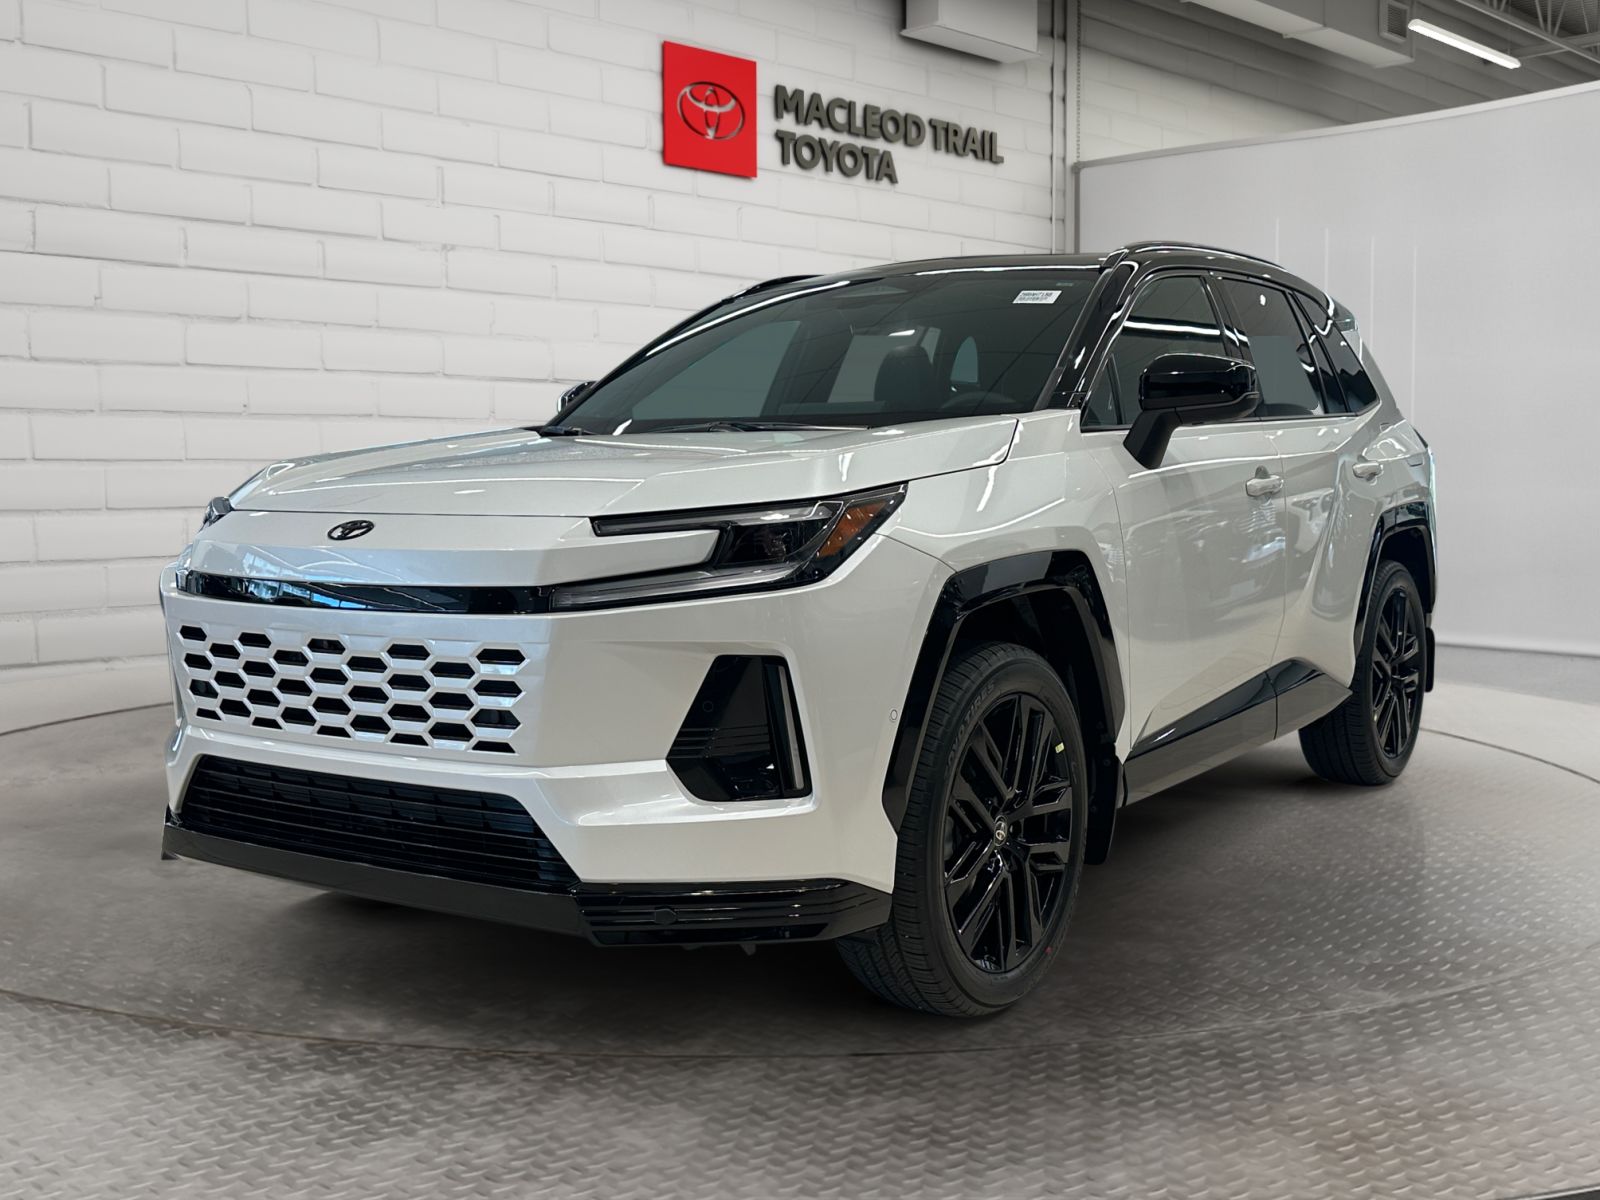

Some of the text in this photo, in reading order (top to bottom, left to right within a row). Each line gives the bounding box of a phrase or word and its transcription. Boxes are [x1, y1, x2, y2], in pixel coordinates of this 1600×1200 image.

[774, 84, 1004, 164] MACLEOD TRAIL
[775, 129, 898, 184] TOYOTA
